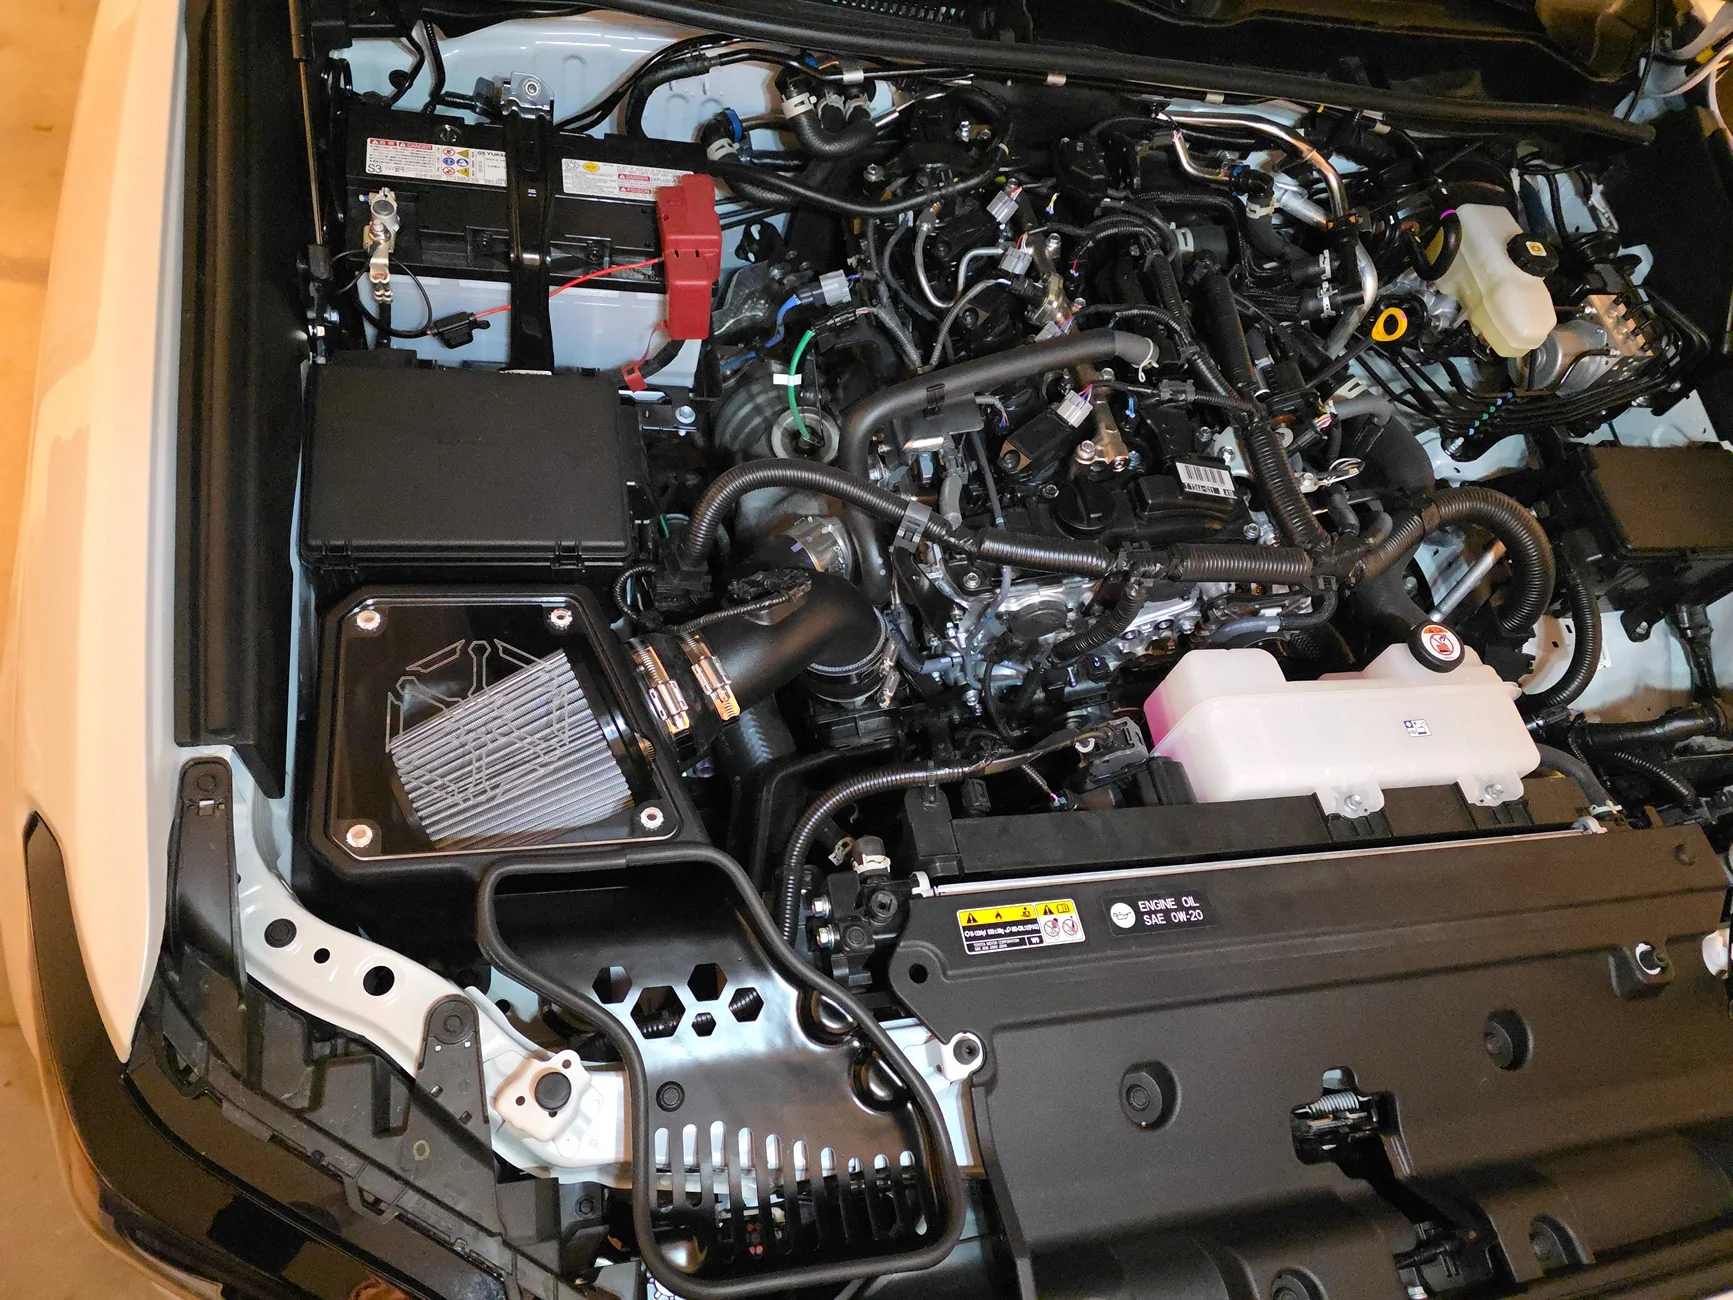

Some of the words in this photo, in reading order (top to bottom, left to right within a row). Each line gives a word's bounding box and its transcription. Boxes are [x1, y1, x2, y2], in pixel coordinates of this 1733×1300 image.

[367, 164, 382, 173] S3
[1138, 898, 1177, 912] ENGINE
[1181, 896, 1200, 908] OIL
[1144, 913, 1166, 926] SAE
[1171, 910, 1204, 922] 0W-20
